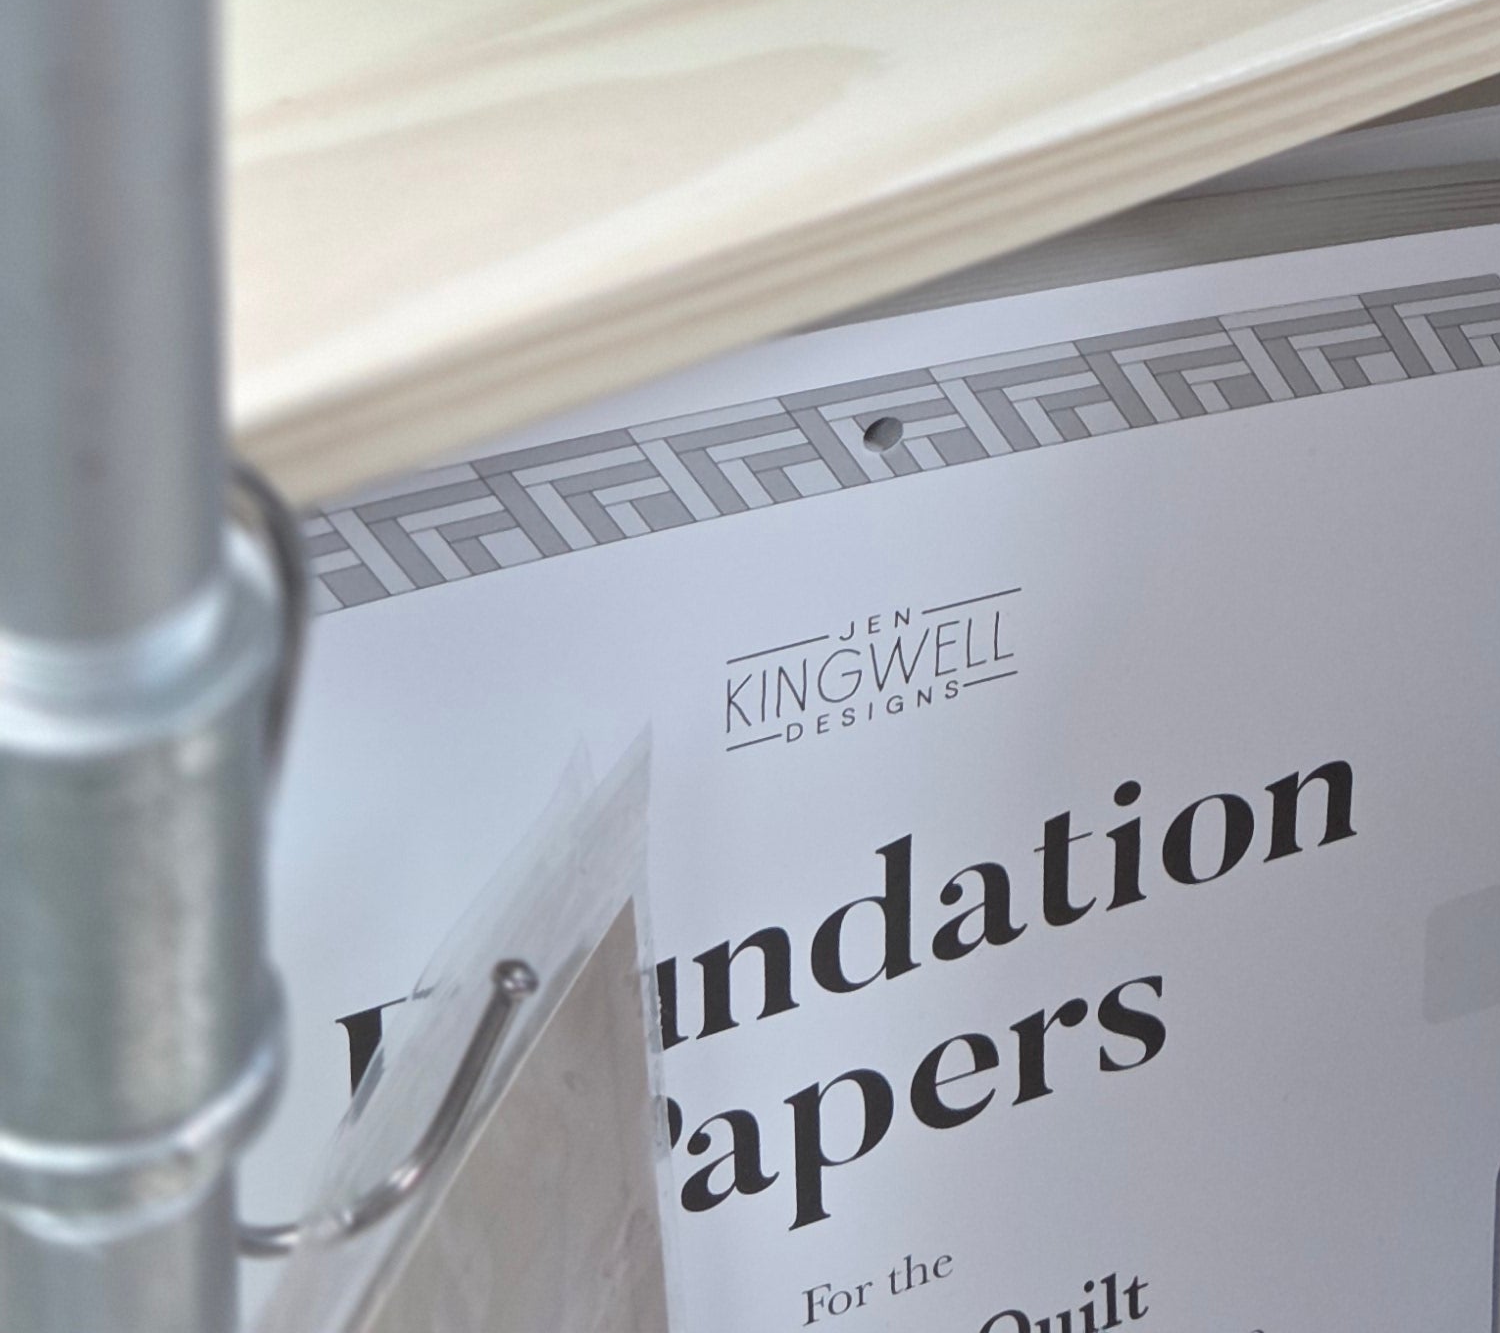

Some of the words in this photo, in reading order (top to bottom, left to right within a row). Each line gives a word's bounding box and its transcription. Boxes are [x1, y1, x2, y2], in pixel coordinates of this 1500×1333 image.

[839, 606, 911, 641] JEN
[726, 611, 1014, 734] KINGWELL
[786, 679, 959, 743] DESIGNS
[660, 973, 1166, 1232] apers
[802, 1277, 874, 1327] For
[888, 1254, 954, 1296] the
